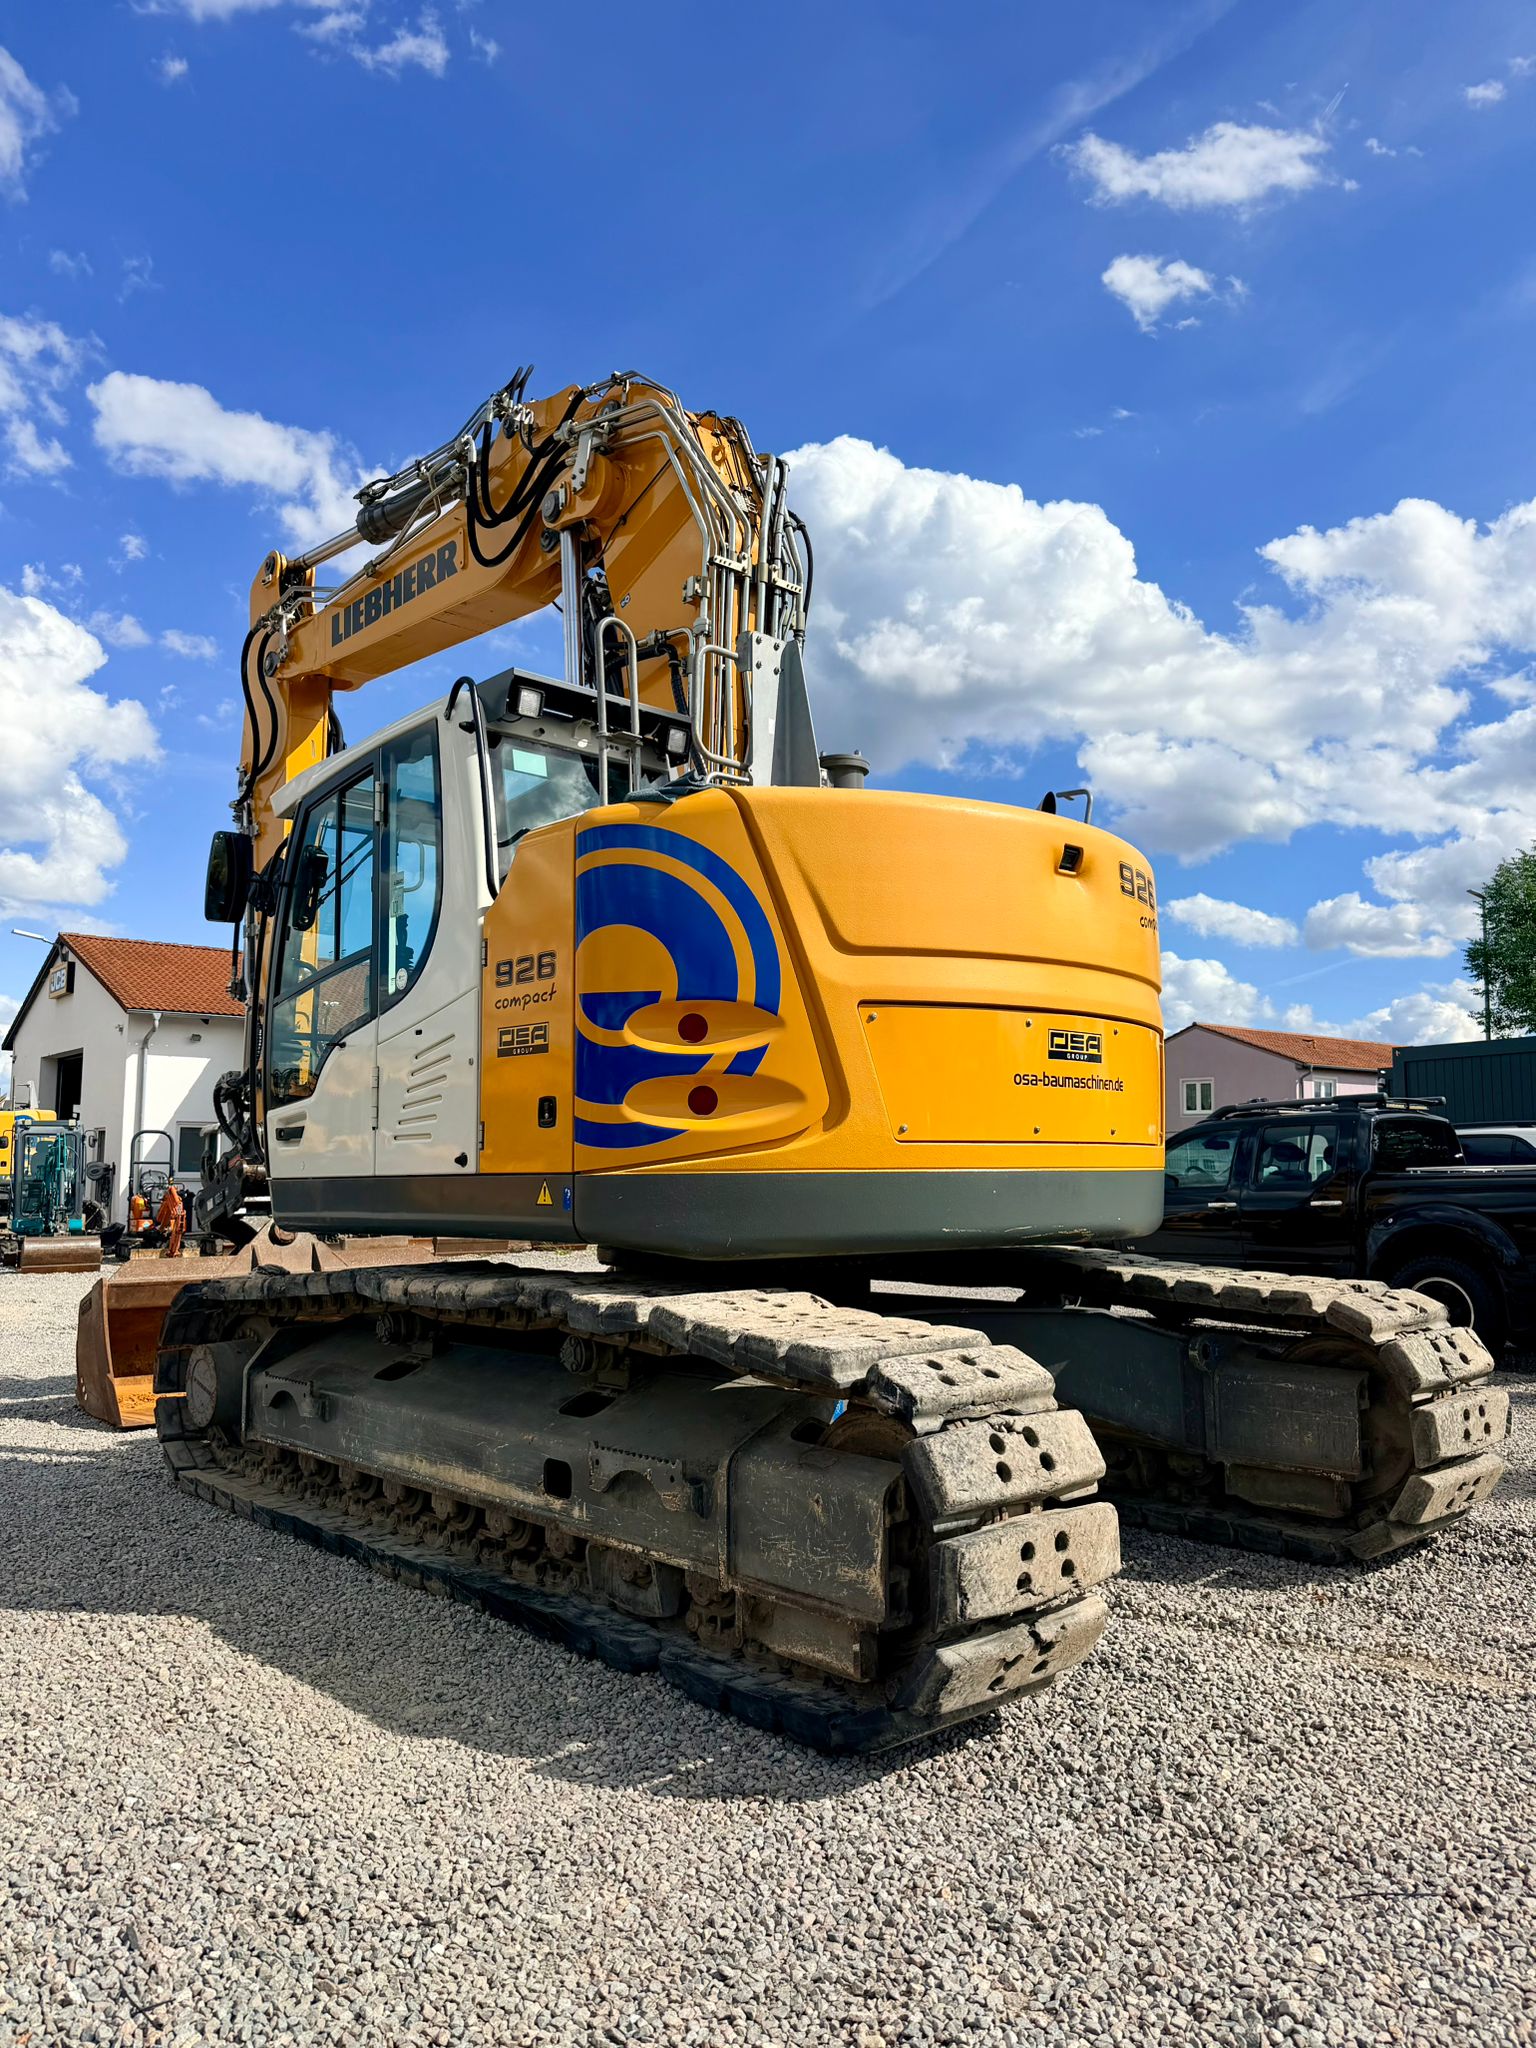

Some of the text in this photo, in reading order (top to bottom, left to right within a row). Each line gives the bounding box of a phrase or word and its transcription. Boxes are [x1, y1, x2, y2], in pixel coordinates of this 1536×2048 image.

[332, 540, 458, 648] LIEBHERR
[1119, 861, 1156, 912] 926
[496, 950, 557, 988] 926
[495, 982, 557, 1011] compact
[512, 1047, 534, 1055] GROUP
[1013, 1071, 1124, 1092] osa-baumaschinen.de
